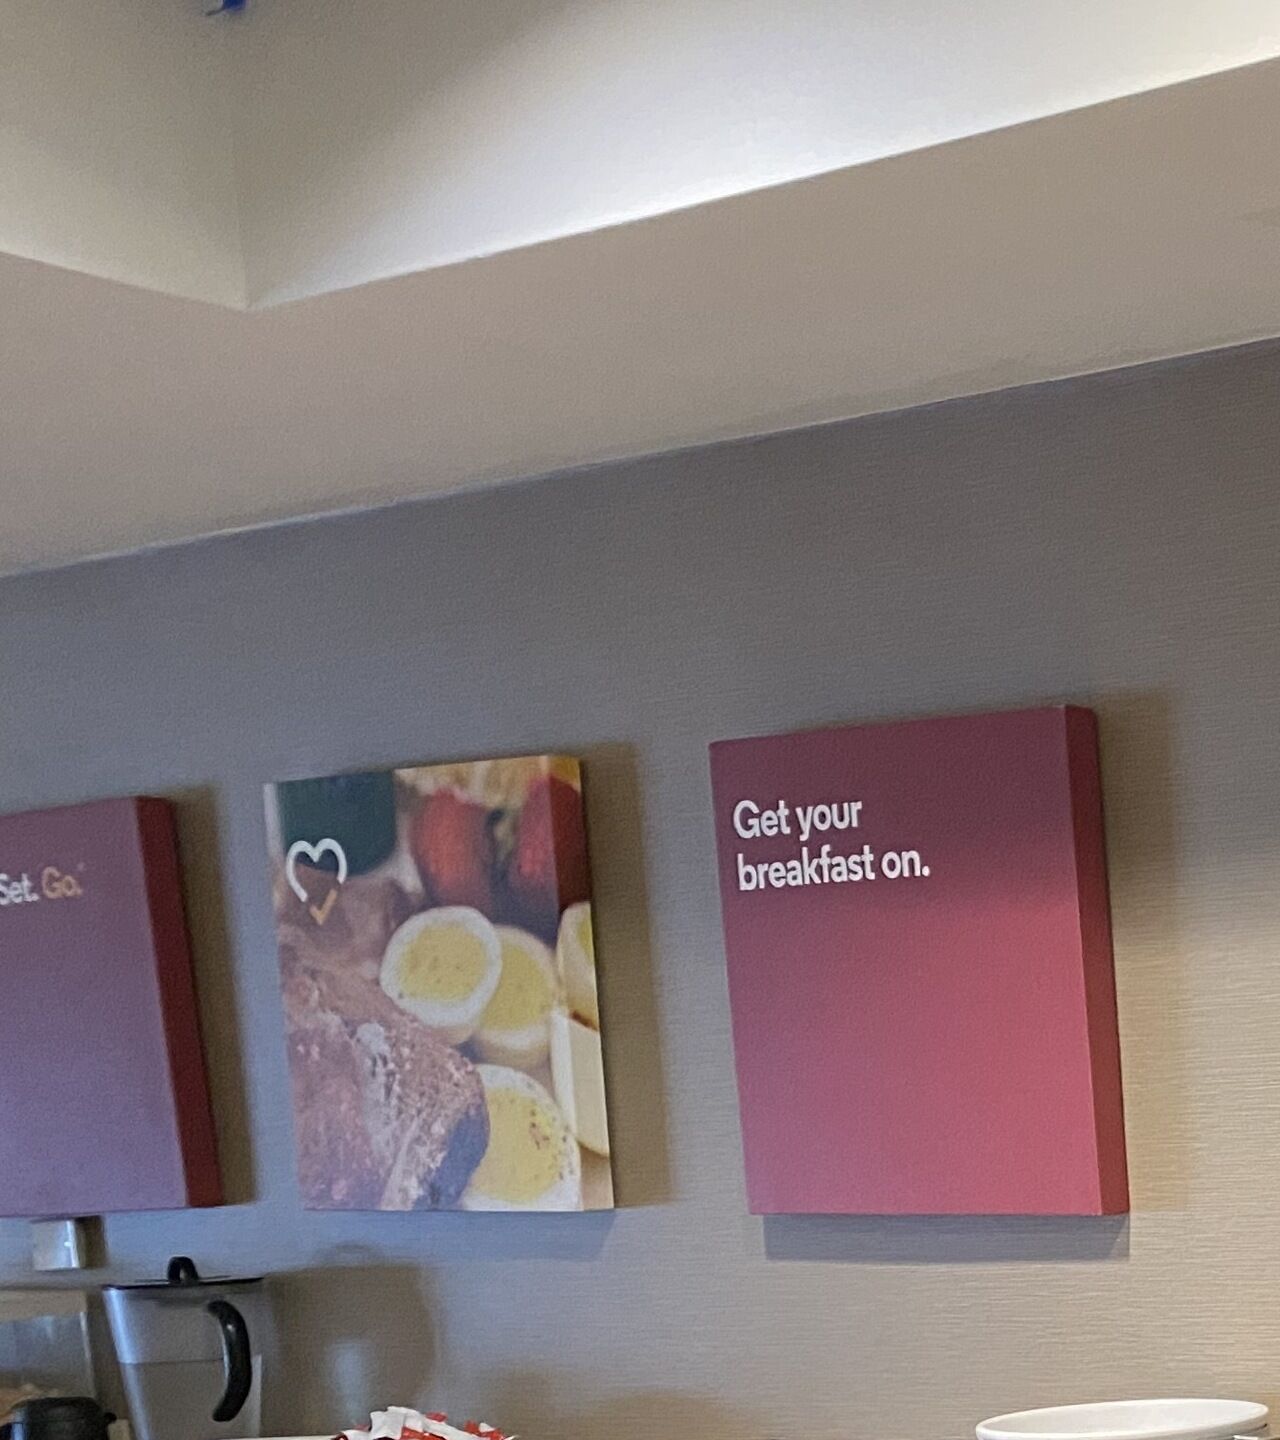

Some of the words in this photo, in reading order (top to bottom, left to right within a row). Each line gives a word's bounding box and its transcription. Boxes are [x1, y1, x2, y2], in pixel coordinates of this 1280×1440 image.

[733, 800, 791, 839] Get
[795, 801, 862, 842] your
[737, 844, 876, 890] breakfast
[881, 850, 930, 878] on.
